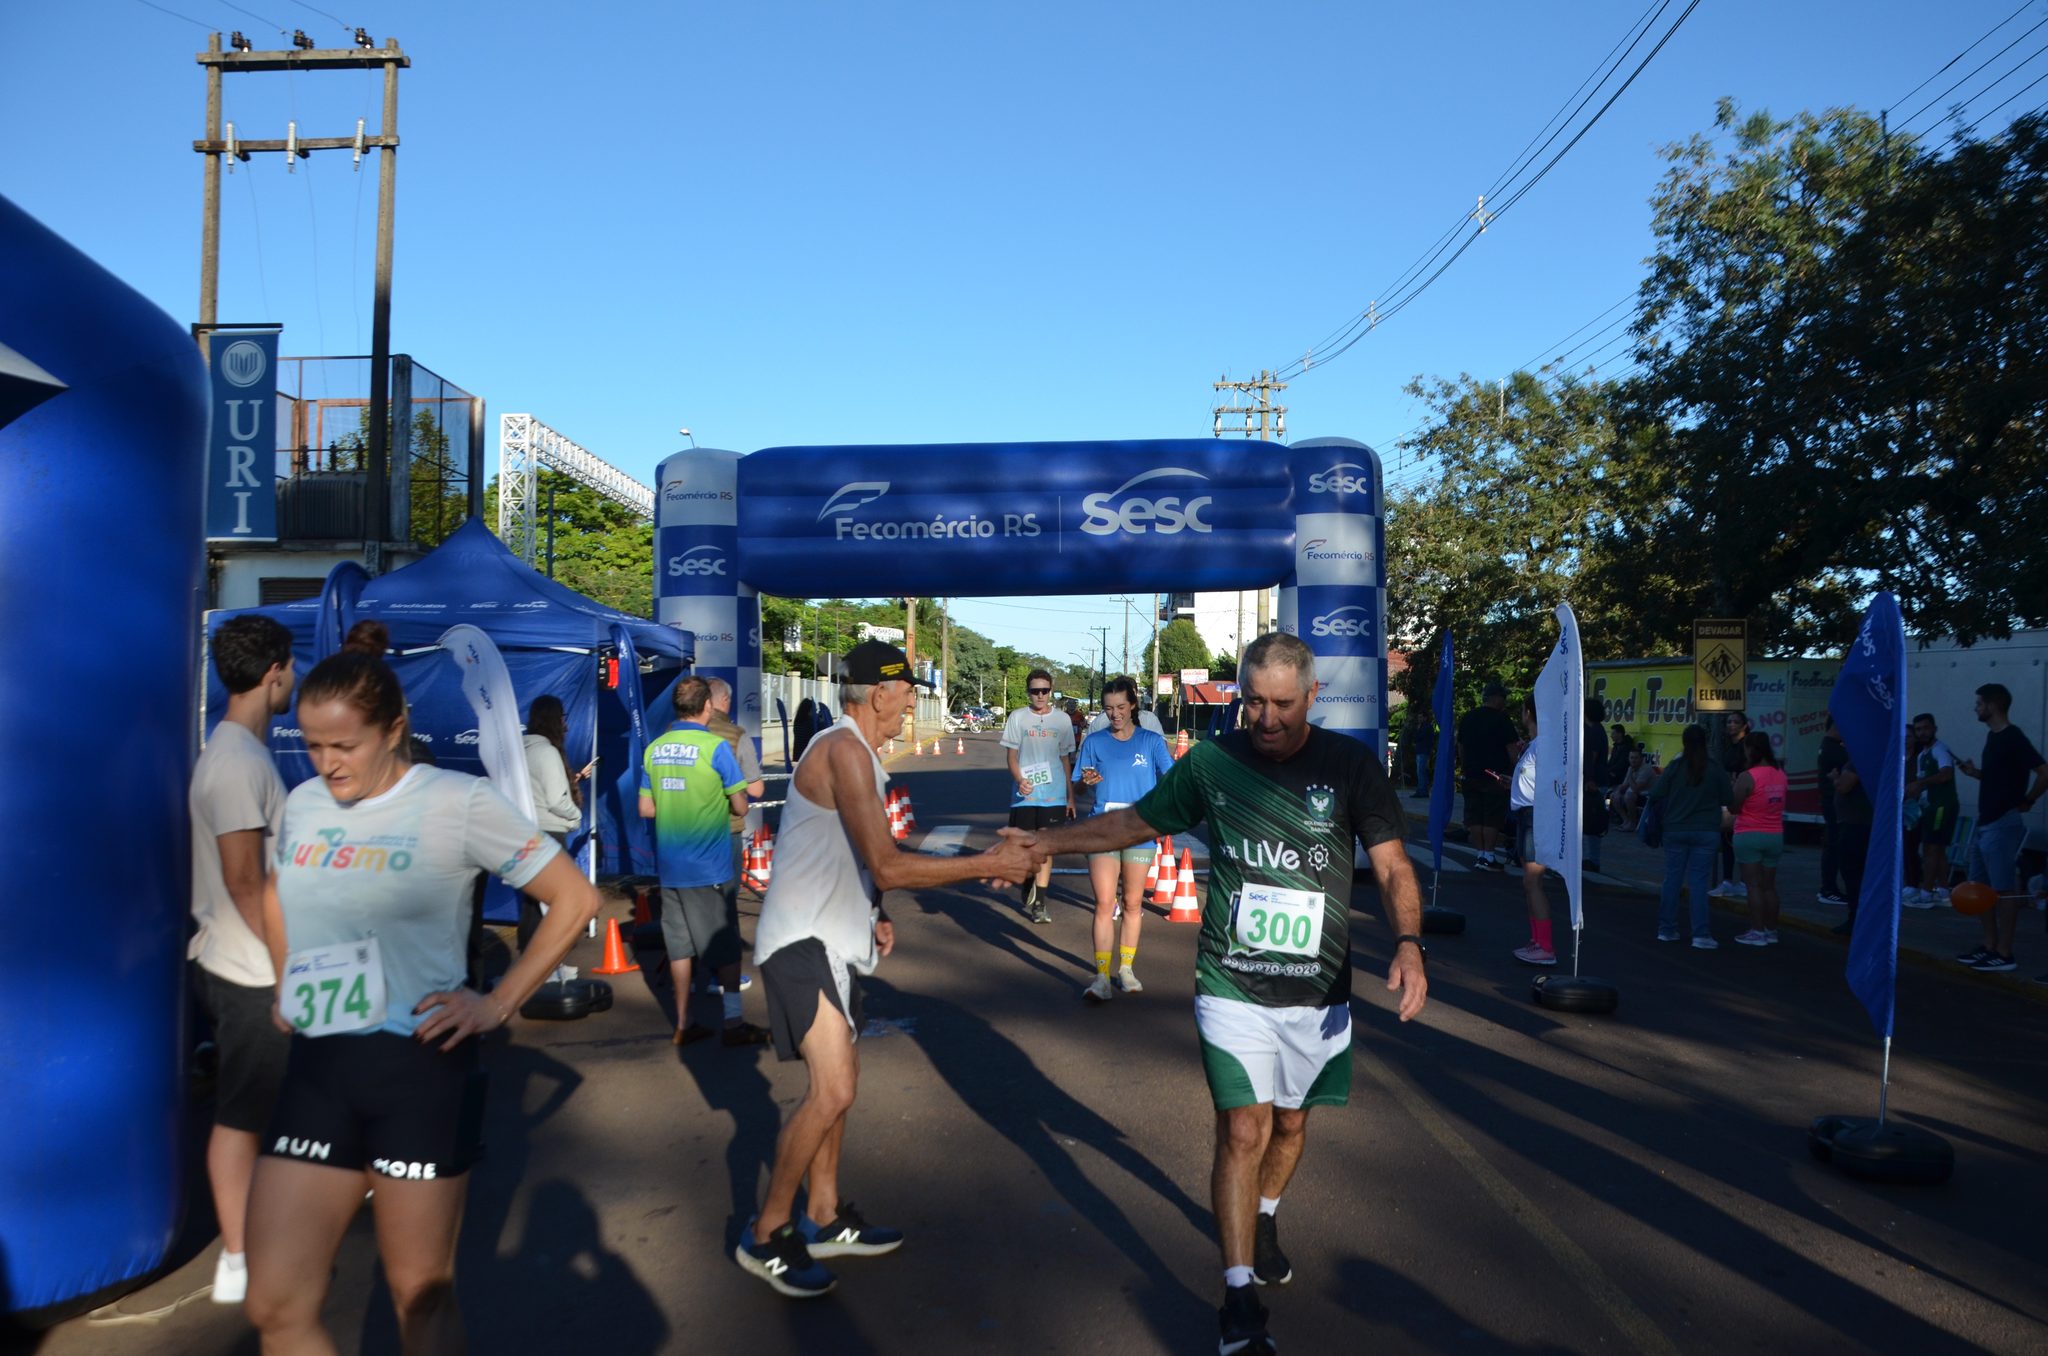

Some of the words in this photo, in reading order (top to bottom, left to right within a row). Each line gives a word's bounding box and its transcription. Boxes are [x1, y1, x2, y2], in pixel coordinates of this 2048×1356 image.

[225, 400, 263, 534] URI
[1308, 473, 1367, 494] Sesc
[666, 490, 718, 501] Fecomércio
[720, 491, 733, 501] RS
[1080, 492, 1213, 536] Sesc
[836, 514, 995, 541] Fecomércio
[1004, 512, 1041, 537] RS
[1307, 551, 1362, 560] Fecomércio
[1364, 552, 1374, 560] RS
[668, 556, 726, 576] Sesc
[1311, 616, 1370, 636] Sesc
[1699, 625, 1742, 635] DEVAGAR
[721, 633, 734, 642] RS
[1315, 694, 1365, 703] ecomércio
[1646, 677, 1696, 725] Truck
[1699, 688, 1742, 701] ELEVADA
[651, 743, 699, 759] ACEMI
[1028, 770, 1048, 786] 565
[279, 841, 412, 873] Autismo
[1247, 908, 1311, 949] 300
[294, 973, 371, 1030] 374
[274, 1136, 331, 1160] RUN
[373, 1158, 437, 1180] MORE
